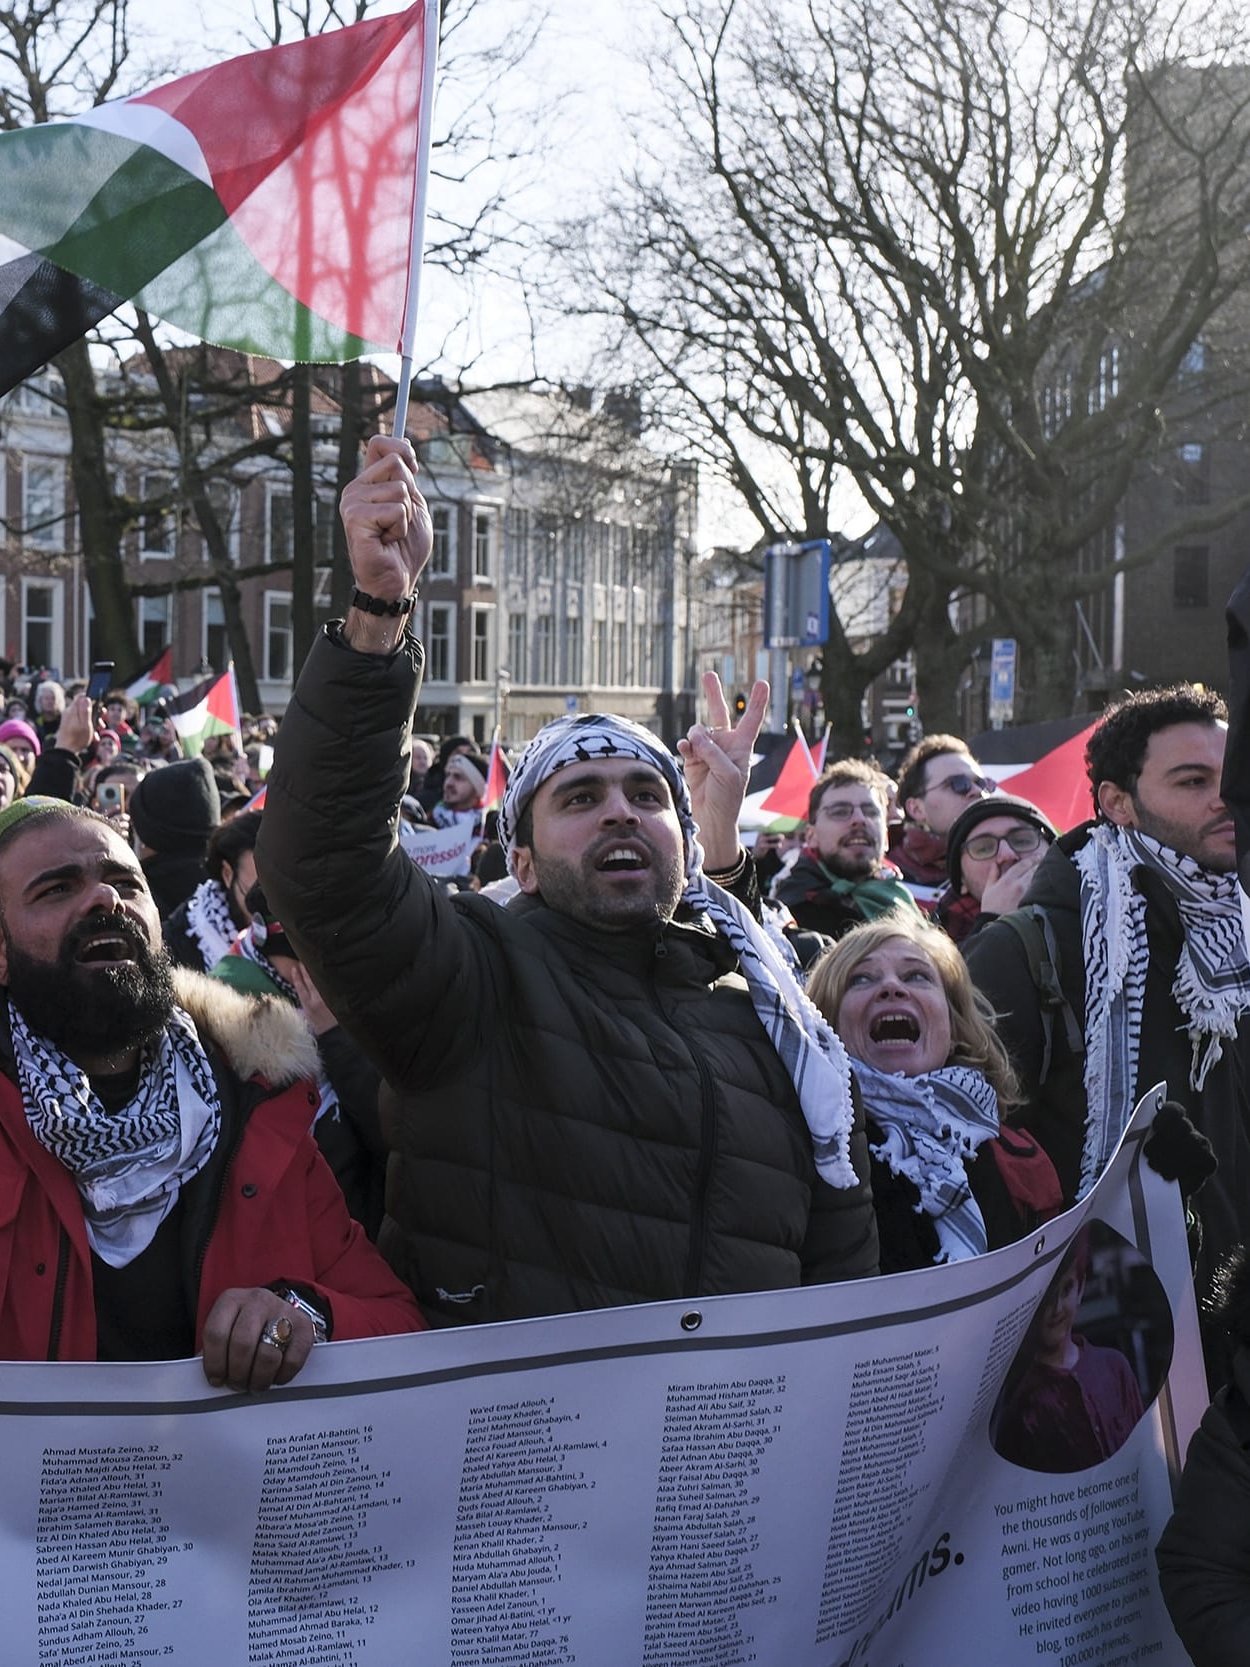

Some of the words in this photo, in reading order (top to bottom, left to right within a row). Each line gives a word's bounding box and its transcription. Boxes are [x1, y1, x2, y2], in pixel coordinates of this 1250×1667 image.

[415, 841, 467, 867] pression
[79, 1447, 115, 1455] Mustafa
[994, 1504, 1013, 1516] You
[1017, 1496, 1047, 1512] might
[1051, 1491, 1074, 1504] have
[1078, 1481, 1113, 1498] become
[1002, 1522, 1019, 1535] the
[1022, 1510, 1077, 1531] thousands
[1080, 1505, 1089, 1521] of
[1092, 1494, 1130, 1514] followers
[1131, 1489, 1138, 1503] of
[1001, 1541, 1029, 1556] Awni.
[1033, 1537, 1047, 1550] He
[1050, 1533, 1071, 1546] was
[1074, 1531, 1080, 1541] a
[1082, 1522, 1110, 1542] young
[1003, 1561, 1039, 1580] gamer.
[1043, 1555, 1062, 1568] Not
[1066, 1550, 1087, 1563] long
[37, 1588, 75, 1600] Abdullah
[156, 1579, 166, 1587] 28
[1007, 1583, 1032, 1600] from
[1036, 1573, 1069, 1591] school
[1073, 1570, 1084, 1582] he
[1012, 1602, 1040, 1616] video
[1044, 1592, 1078, 1609] having
[1082, 1583, 1102, 1600] 1000
[38, 1602, 60, 1612] Nada
[63, 1597, 92, 1608] Khaled
[95, 1596, 111, 1604] Abu
[142, 1592, 151, 1600] 28
[1020, 1624, 1033, 1636] He
[1037, 1613, 1071, 1632] invited
[1074, 1602, 1110, 1621] everyone
[1112, 1598, 1120, 1608] to
[249, 1625, 297, 1640] Muhammad
[300, 1621, 329, 1631] Ahmad
[366, 1616, 374, 1624] 12
[1037, 1640, 1062, 1653] blog,
[1065, 1636, 1075, 1647] to
